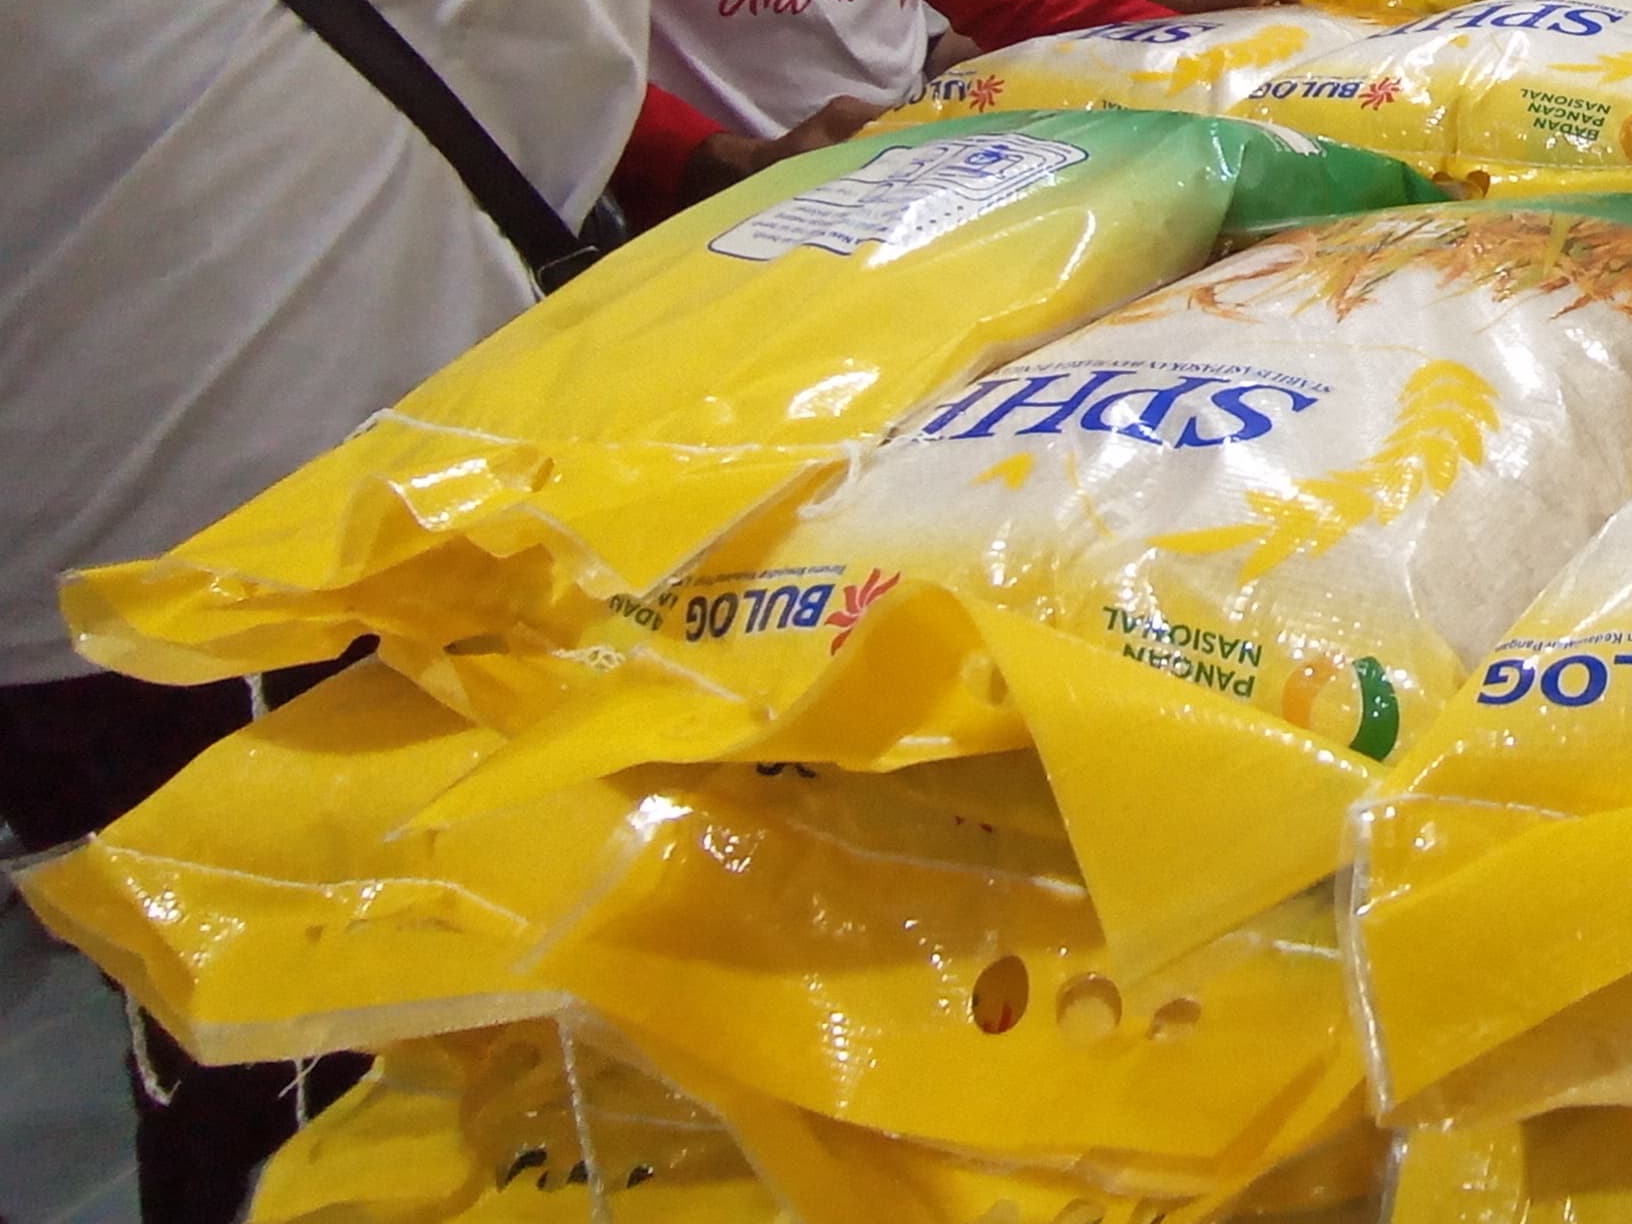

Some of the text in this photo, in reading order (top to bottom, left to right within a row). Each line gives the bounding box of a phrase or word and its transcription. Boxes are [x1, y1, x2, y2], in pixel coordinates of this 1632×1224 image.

[1248, 81, 1362, 100] BULOG
[1519, 88, 1612, 115] NASIONAL
[1527, 102, 1606, 127] PANGAN
[1532, 118, 1600, 142] BADAN
[686, 583, 836, 643] BULOG
